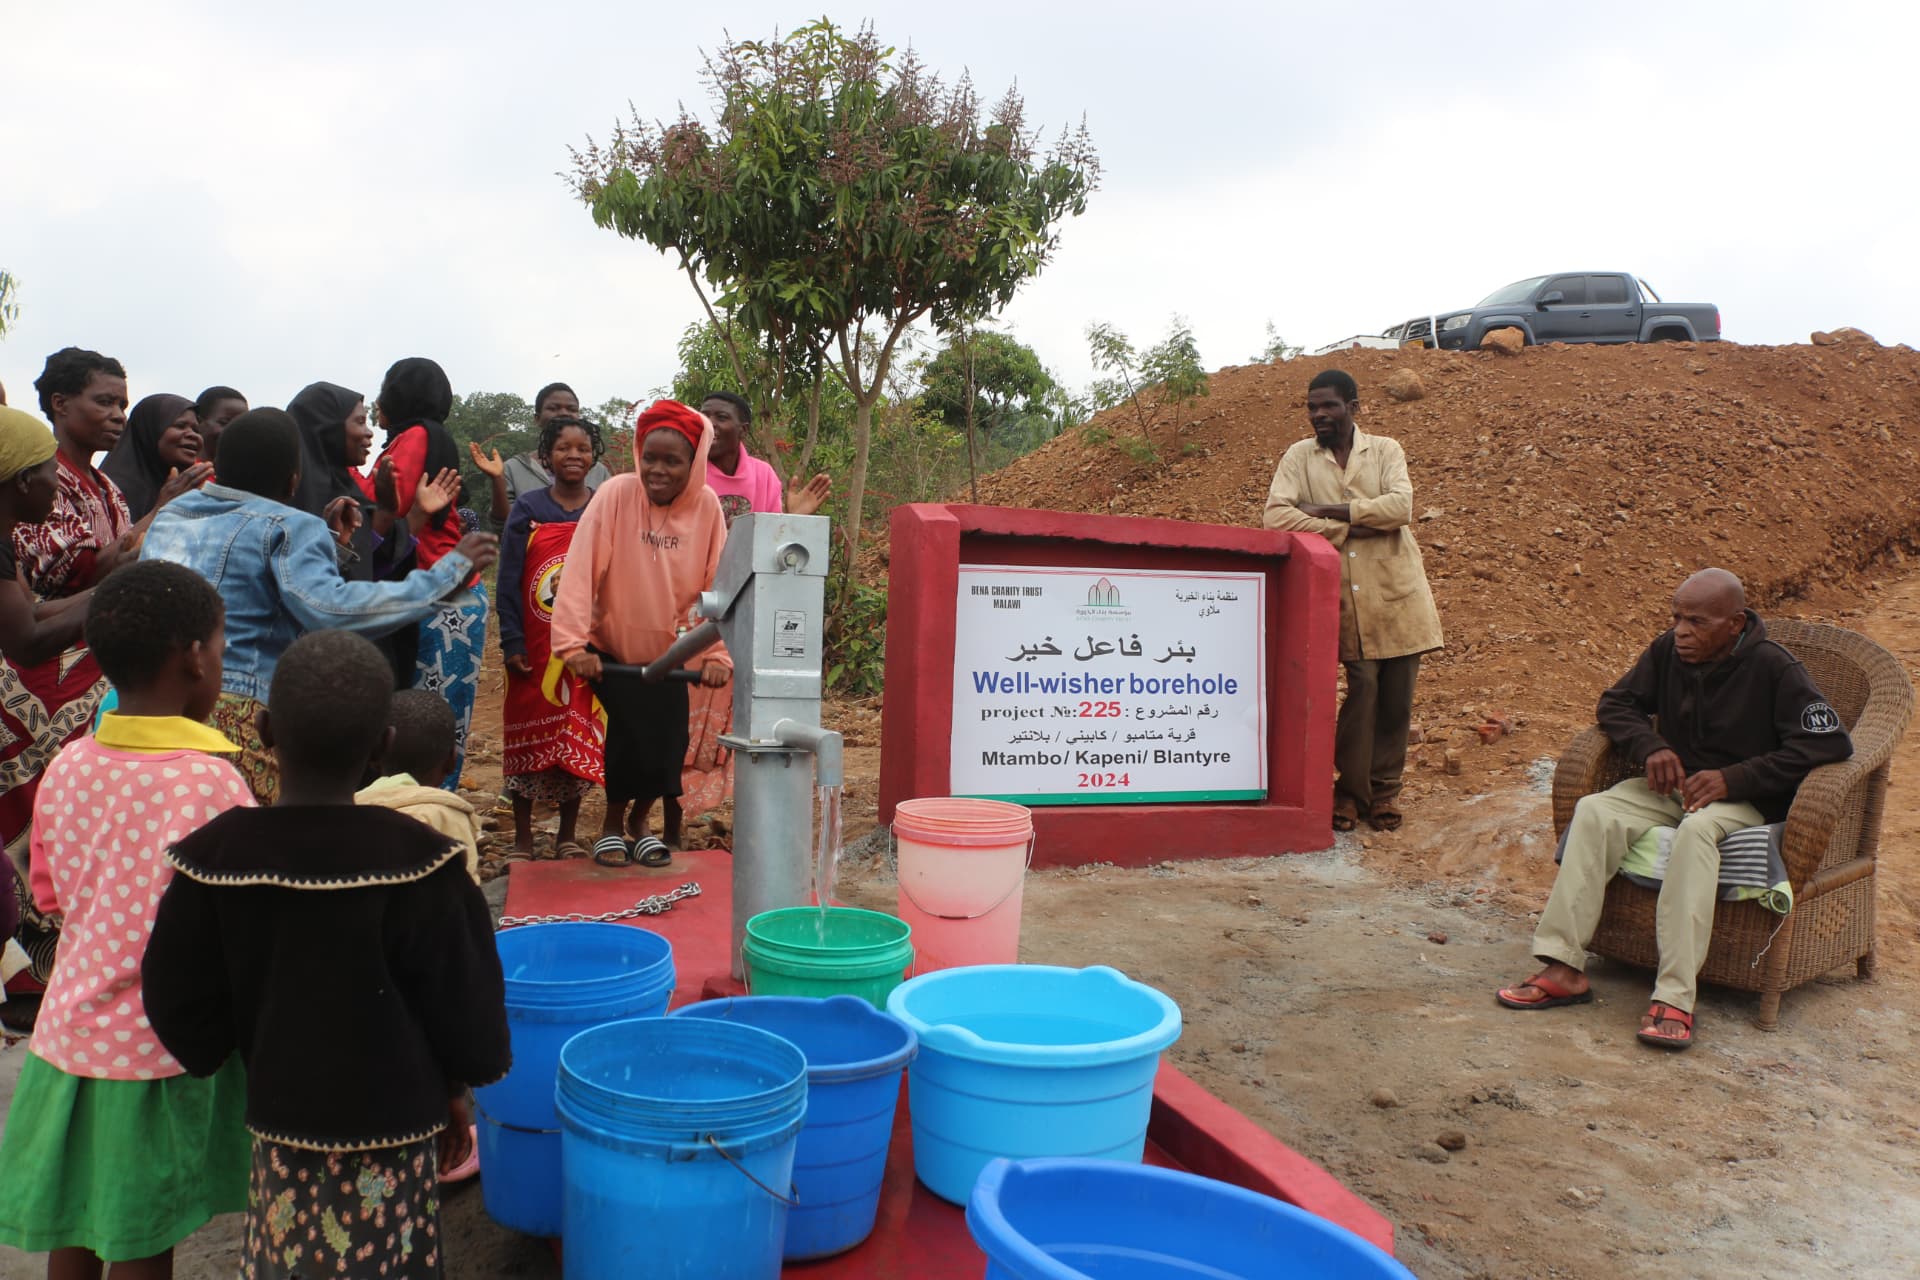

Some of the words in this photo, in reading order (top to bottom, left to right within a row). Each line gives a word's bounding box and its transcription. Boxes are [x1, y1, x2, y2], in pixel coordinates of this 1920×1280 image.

[991, 586, 1020, 597] CHARITY
[1022, 587, 1042, 597] TRUST
[993, 600, 1021, 609] MALAWI
[1005, 635, 1062, 662] خير
[1074, 633, 1143, 662] فاعل
[1153, 640, 1196, 664] بئر
[972, 671, 1125, 694] Well-wisher
[1130, 672, 1238, 695] borehole
[981, 706, 1044, 721] project
[1197, 703, 1219, 719] رقم
[1007, 729, 1050, 744] بلانتير
[1066, 729, 1107, 745] كابيني
[1124, 729, 1163, 743] متامبو
[1168, 727, 1196, 743] قرية
[1154, 749, 1231, 767] Blantyre
[1077, 772, 1130, 788] 2024
